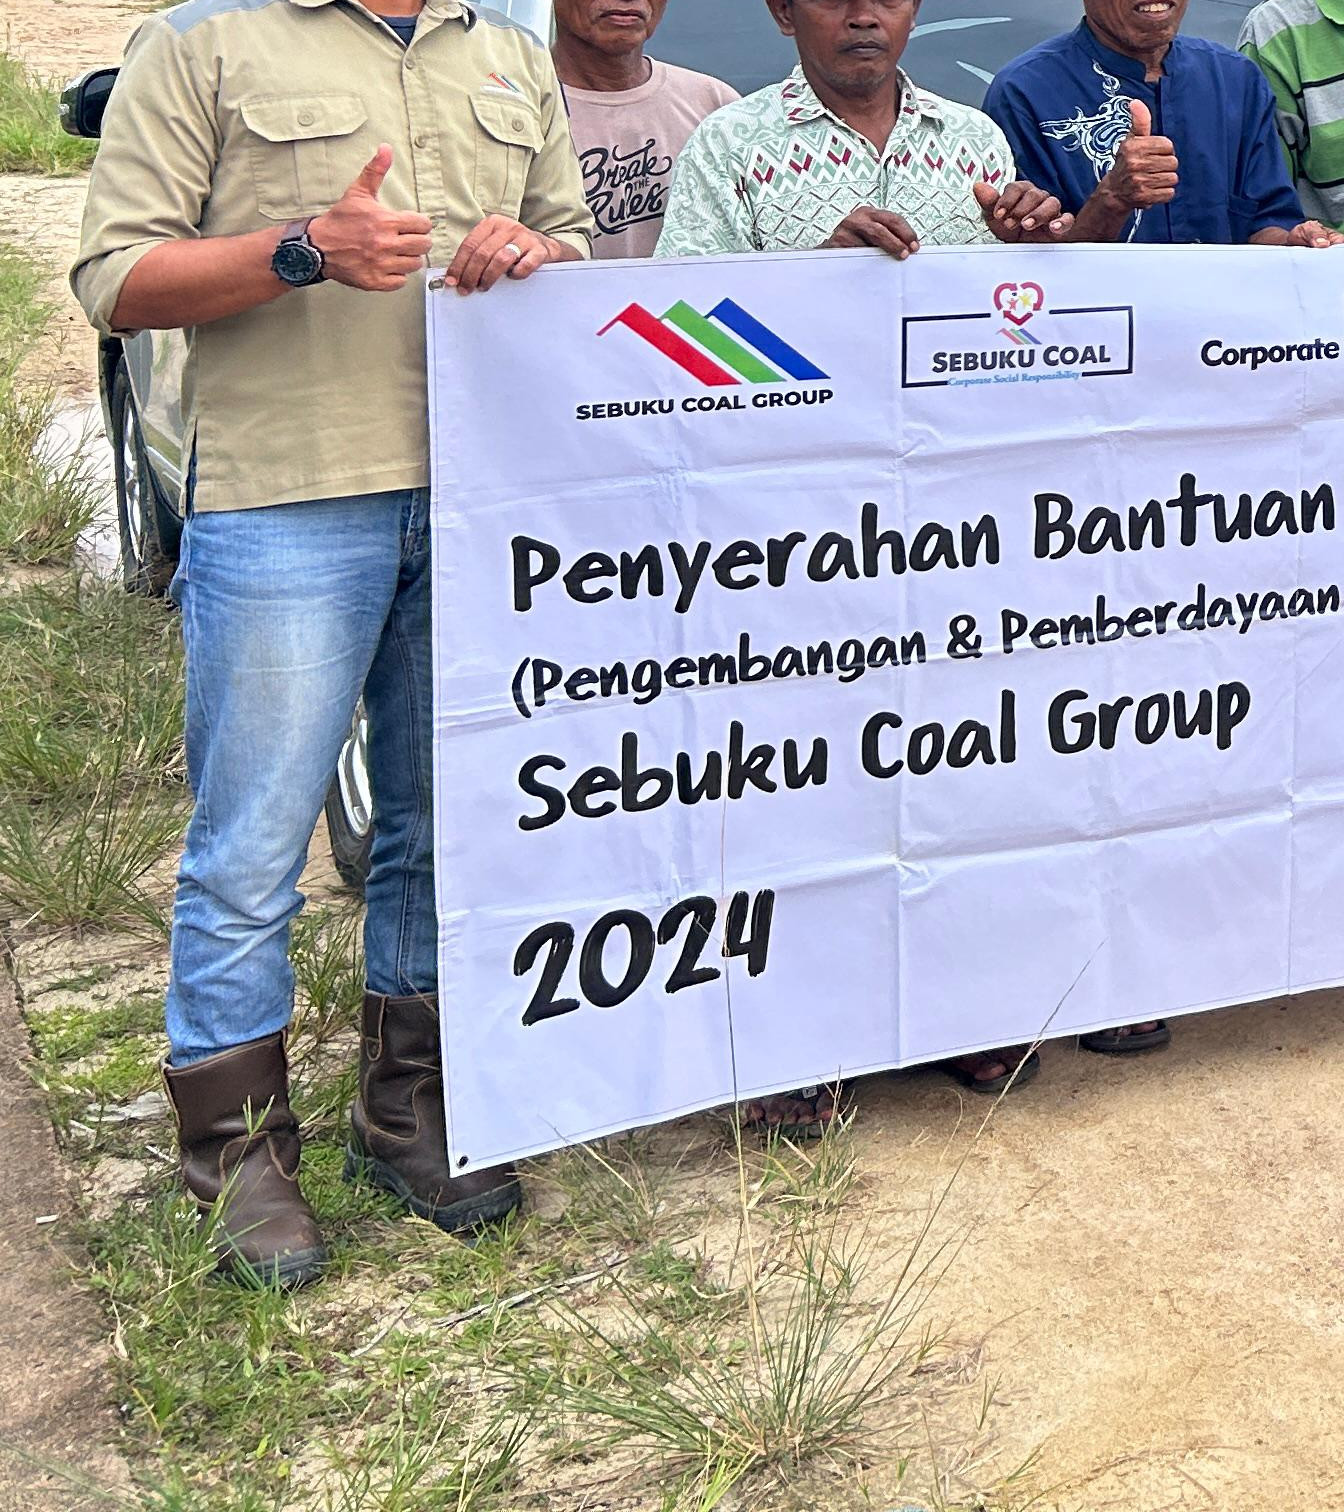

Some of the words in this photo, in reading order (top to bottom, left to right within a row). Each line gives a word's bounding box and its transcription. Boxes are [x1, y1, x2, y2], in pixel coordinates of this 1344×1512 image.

[579, 138, 672, 197] Break
[633, 177, 650, 191] THE
[586, 183, 669, 235] Rules
[932, 349, 1036, 374] SEBUKU
[1042, 345, 1112, 368] COAL
[1200, 338, 1340, 370] Corporate
[576, 399, 675, 420] SEBUKU
[681, 395, 746, 413] COAL
[751, 389, 834, 408] GROUP
[511, 502, 1000, 613] Penyerahan
[1033, 472, 1336, 560] Bantuan
[511, 632, 926, 718] (Pengembangan
[948, 614, 983, 660] &
[1001, 583, 1340, 654] Pemberdayaan
[518, 720, 828, 831] Sebuku
[861, 689, 1016, 780] Coal
[1048, 681, 1252, 754] Group
[513, 889, 775, 1026] 2024
